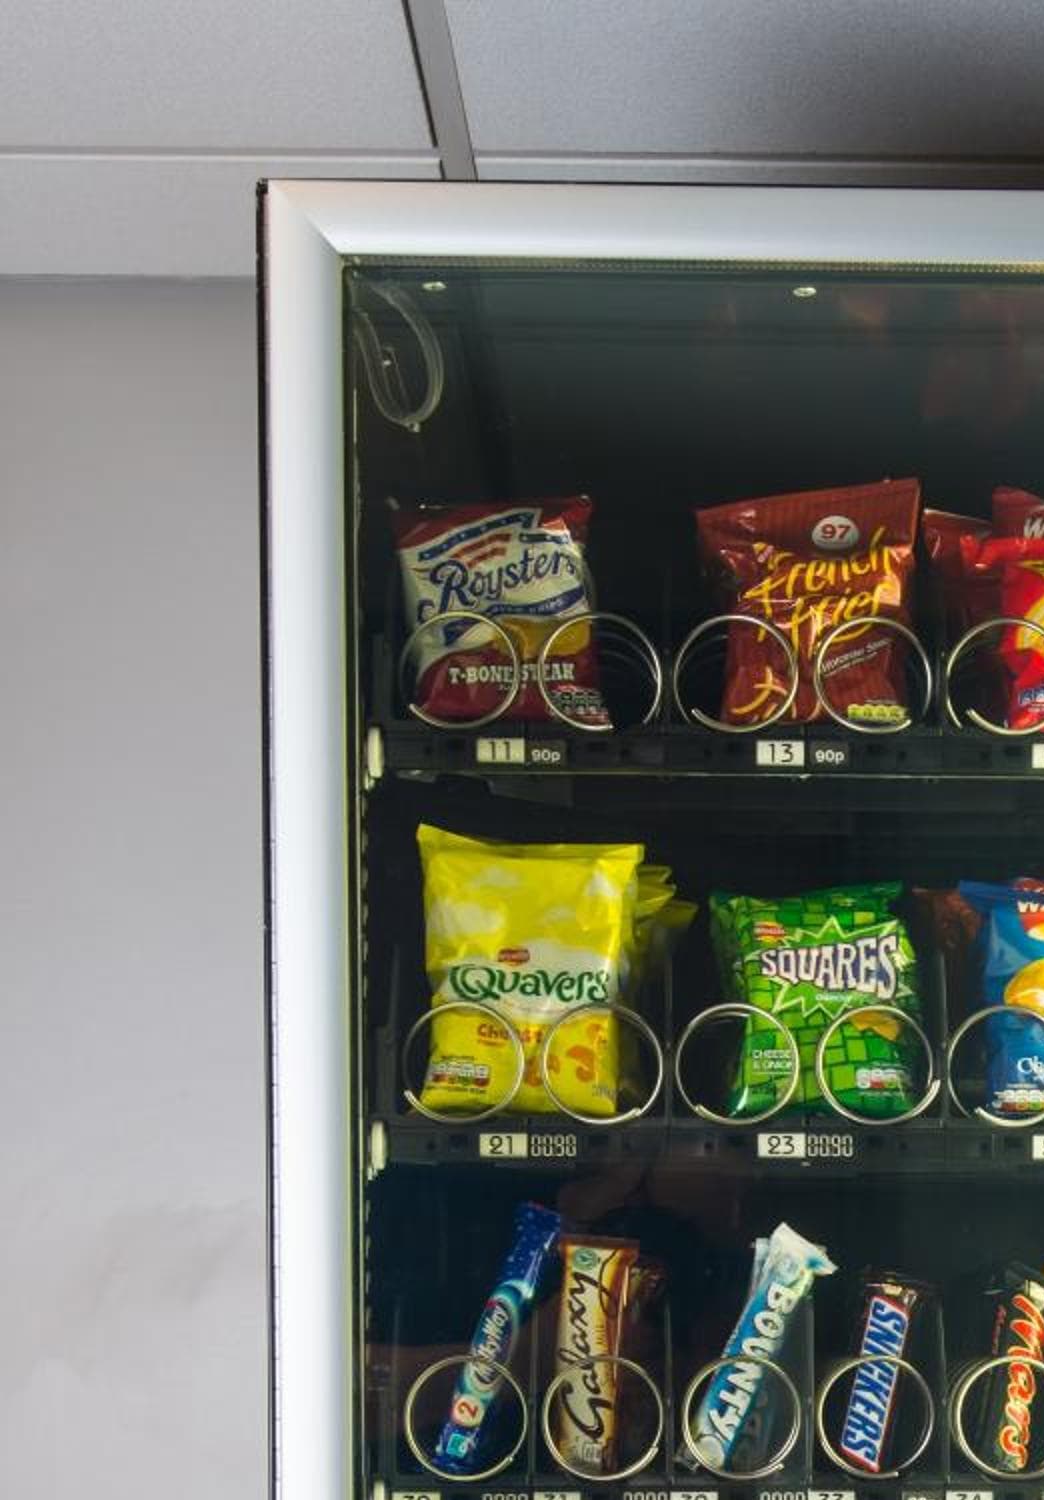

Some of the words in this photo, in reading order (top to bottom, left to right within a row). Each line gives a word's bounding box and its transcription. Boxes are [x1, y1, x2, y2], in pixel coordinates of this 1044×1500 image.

[820, 524, 851, 540] 97
[450, 664, 515, 684] T-BONE
[490, 742, 511, 760] 11
[531, 749, 561, 764] 90p
[768, 743, 794, 762] 13
[814, 749, 845, 764] 90p
[760, 935, 897, 1000] SQUARES
[450, 963, 609, 1002] Quavers
[489, 1136, 514, 1154] 21
[768, 1136, 795, 1155] 23
